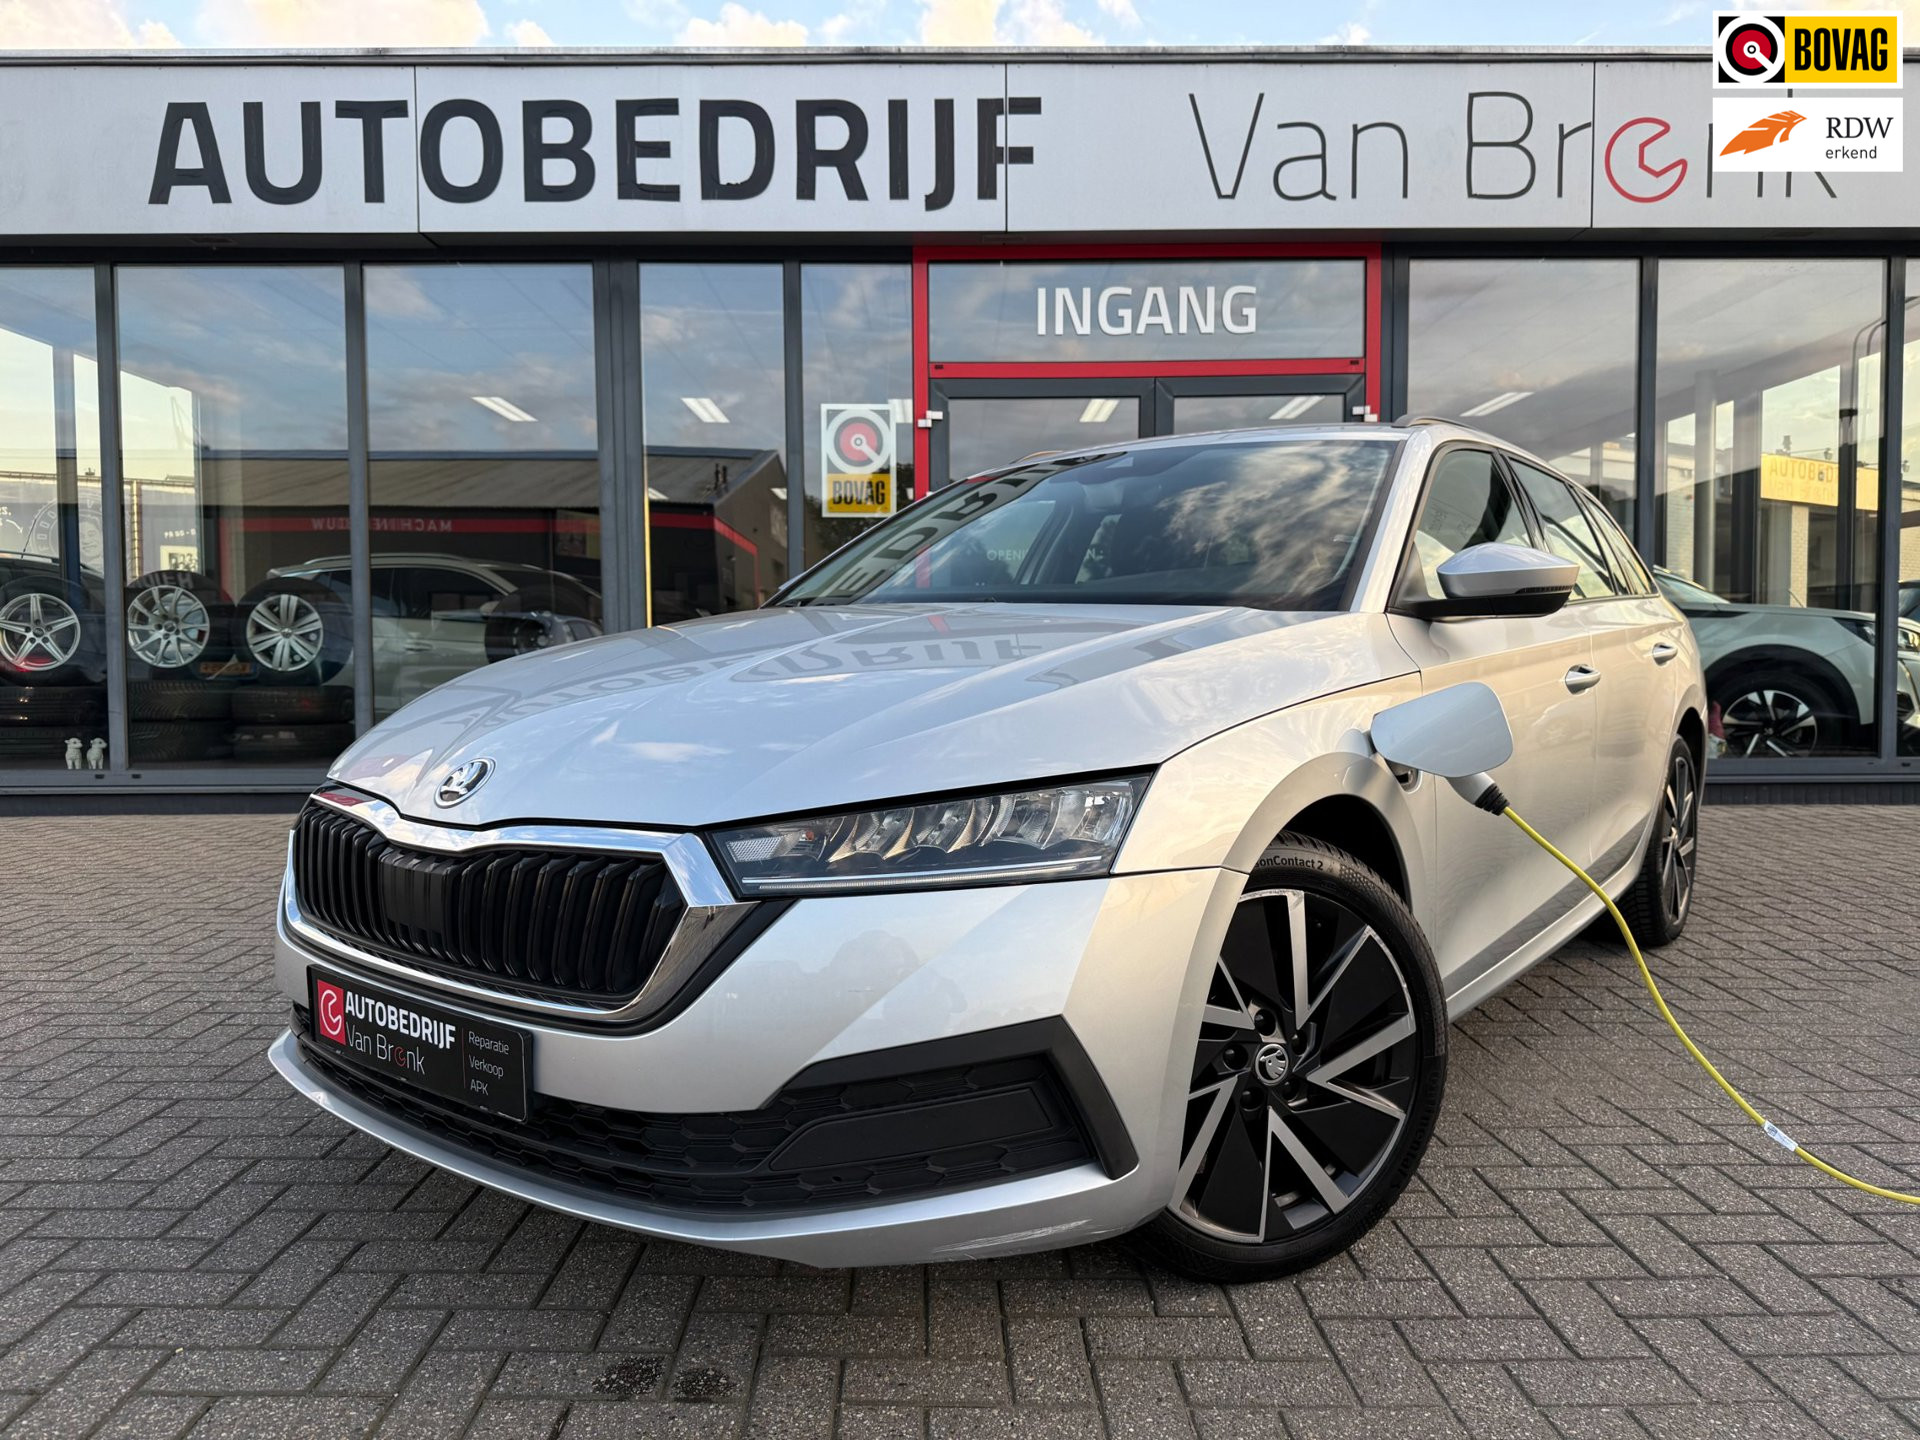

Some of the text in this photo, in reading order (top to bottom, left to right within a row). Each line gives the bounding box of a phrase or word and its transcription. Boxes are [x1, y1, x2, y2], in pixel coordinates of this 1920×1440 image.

[148, 97, 1041, 211] AUTOBEDRIJF
[1189, 92, 1408, 201] Van
[1037, 285, 1257, 336] INGANG
[832, 480, 886, 505] BOVAG
[345, 991, 457, 1050] AUTOBEDRIJF
[345, 1022, 372, 1056] Van
[468, 1031, 510, 1055] Reparatie
[468, 1054, 504, 1079] Verkoop
[470, 1079, 489, 1096] APK
